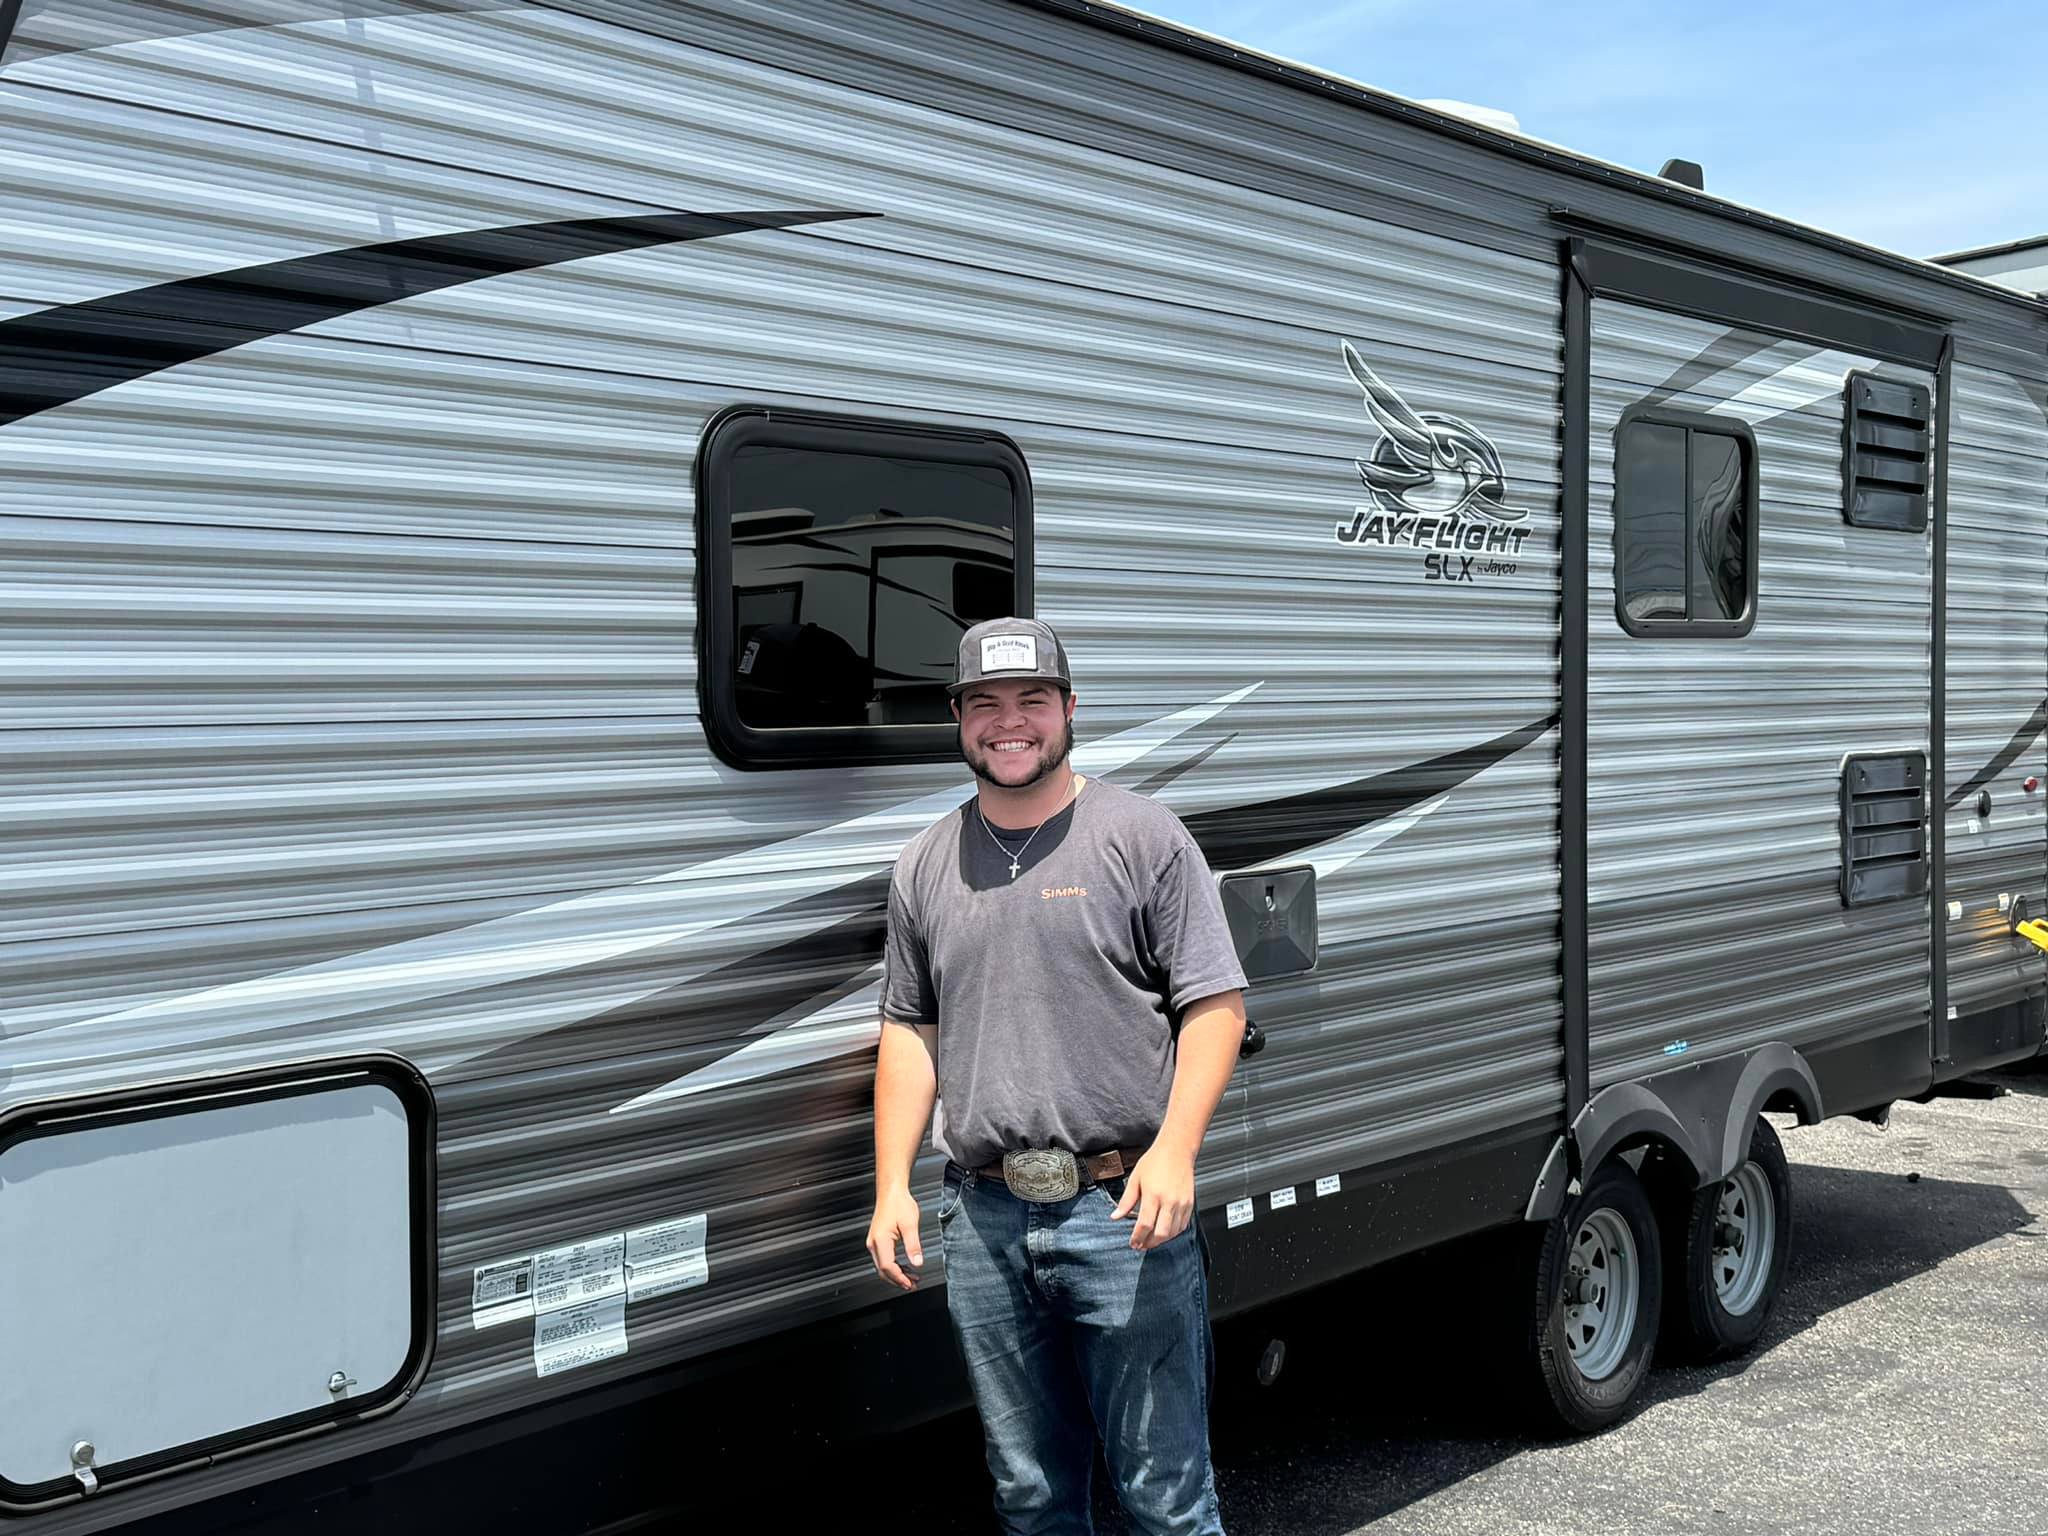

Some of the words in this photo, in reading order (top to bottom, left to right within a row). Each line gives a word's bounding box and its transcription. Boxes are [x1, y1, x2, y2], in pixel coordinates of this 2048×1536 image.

[1337, 511, 1412, 545] JAY
[1413, 516, 1532, 554] FLIGHT
[1424, 553, 1475, 582] SLX
[1484, 559, 1517, 577] Jayco
